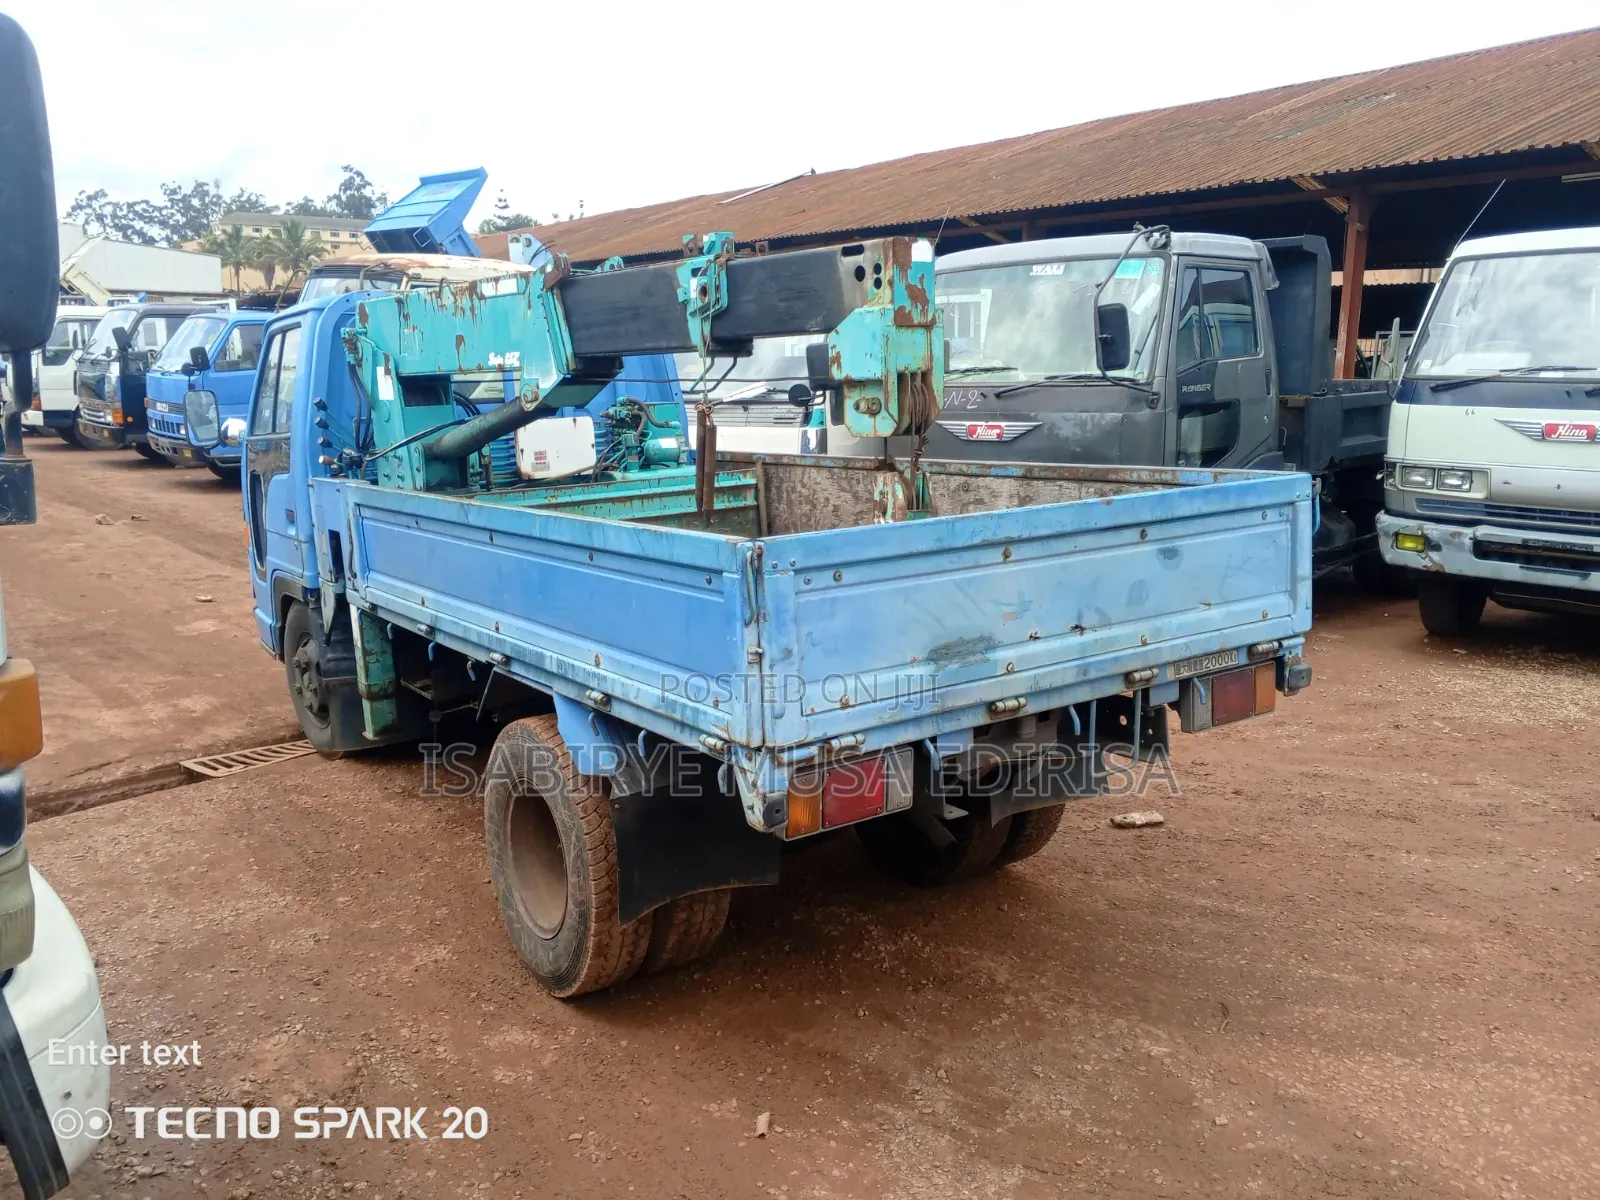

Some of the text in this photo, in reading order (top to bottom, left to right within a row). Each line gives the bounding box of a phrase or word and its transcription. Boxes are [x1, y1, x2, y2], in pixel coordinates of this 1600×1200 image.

[1181, 383, 1212, 393] RANGER
[972, 424, 1001, 439] Hino
[1551, 424, 1588, 440] Hino
